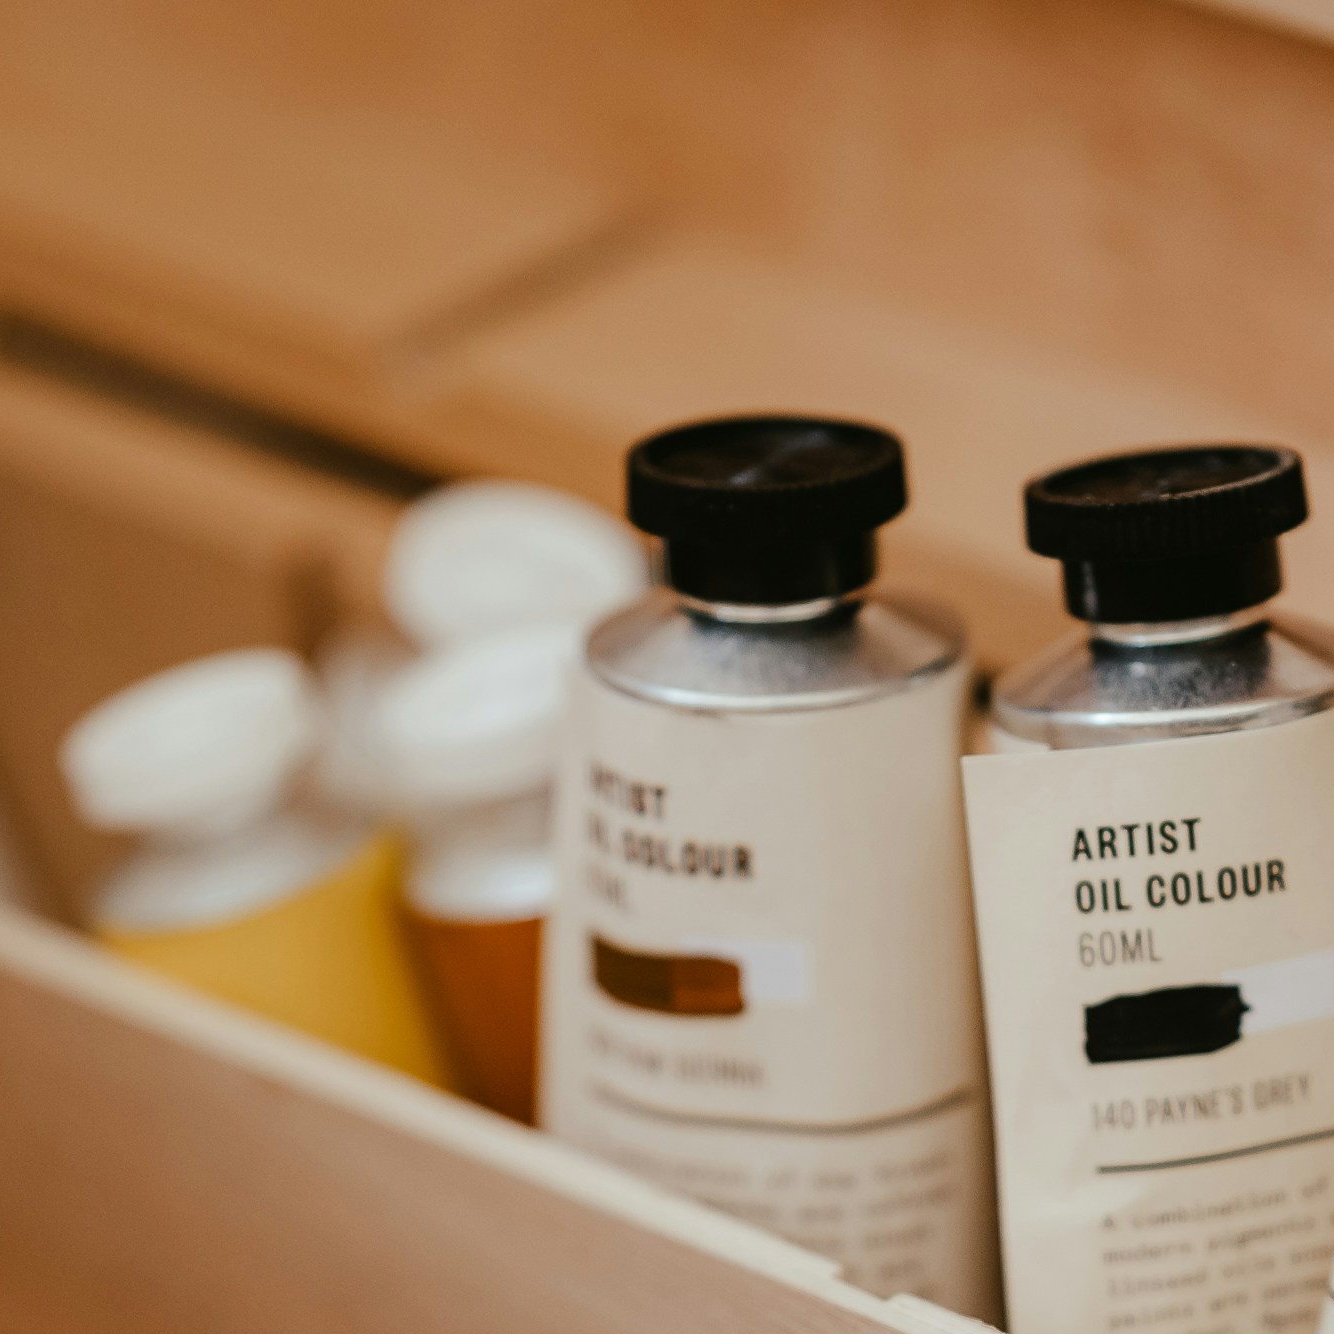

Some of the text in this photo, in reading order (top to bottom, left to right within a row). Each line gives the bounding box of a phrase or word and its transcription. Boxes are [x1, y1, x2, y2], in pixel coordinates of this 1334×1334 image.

[1072, 817, 1201, 862] ARTIST
[1075, 859, 1287, 914] OIL COLOUR
[1078, 928, 1163, 967] 60ML
